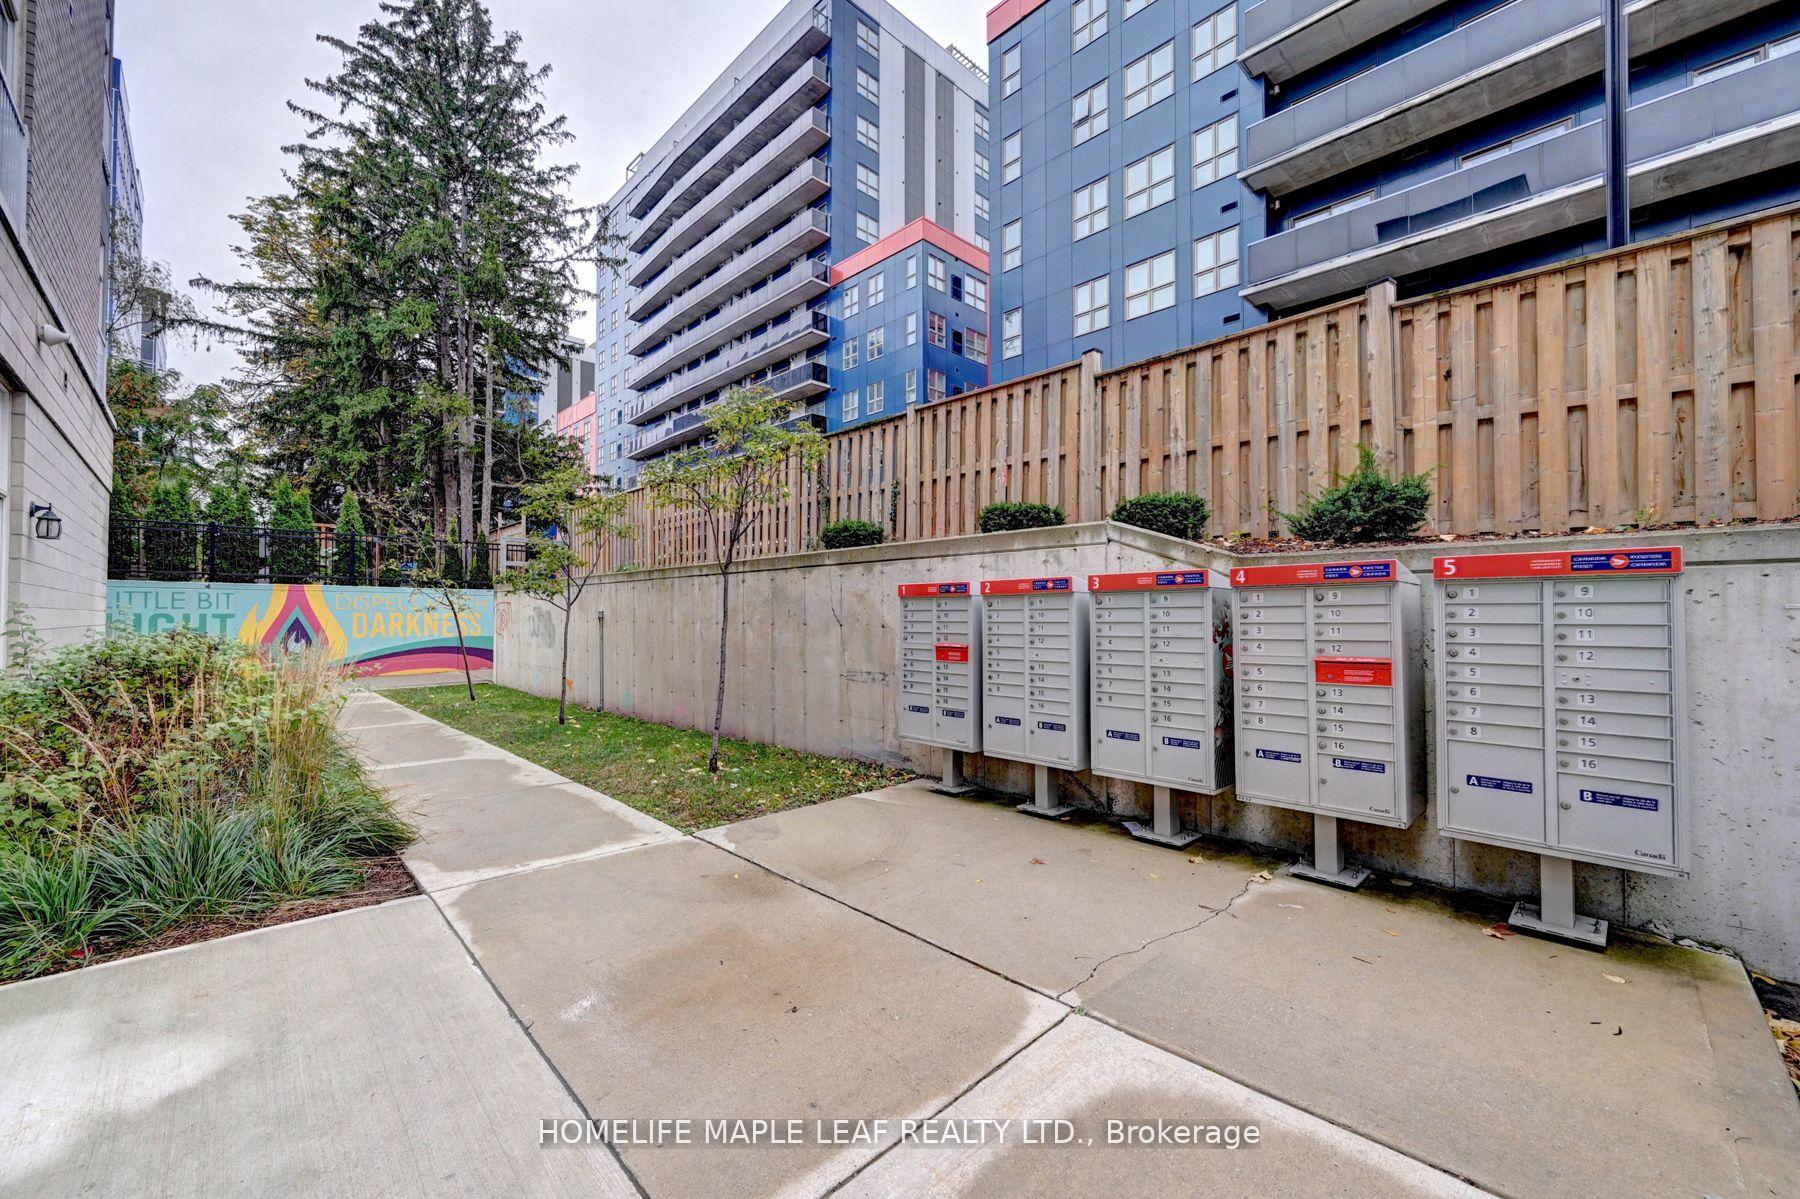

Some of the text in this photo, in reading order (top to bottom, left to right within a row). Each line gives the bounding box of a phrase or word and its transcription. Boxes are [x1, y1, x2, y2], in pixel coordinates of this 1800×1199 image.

[1444, 559, 1456, 575] 5
[1236, 570, 1246, 583] 4
[985, 582, 990, 593] 2
[1093, 577, 1099, 589] 3
[902, 586, 905, 595] 1
[1581, 587, 1589, 596] 9
[107, 591, 234, 610] ITTLE BIT
[1332, 592, 1338, 600] 9
[1469, 608, 1475, 617] 2
[1578, 608, 1593, 617] 10
[352, 612, 483, 639] DARKNESS
[1470, 628, 1476, 636] 3
[1579, 630, 1592, 638] 11
[1579, 651, 1594, 660] 12
[1470, 668, 1476, 676] 5
[1470, 687, 1476, 696] 6
[1580, 694, 1595, 704] 13
[1470, 707, 1477, 715] 7
[1581, 716, 1596, 725] 14
[1470, 727, 1477, 735] 8
[1581, 738, 1596, 747] 15
[1335, 759, 1342, 767] B
[1581, 759, 1596, 769] 16
[1469, 776, 1478, 785] A
[1583, 791, 1592, 801] B
